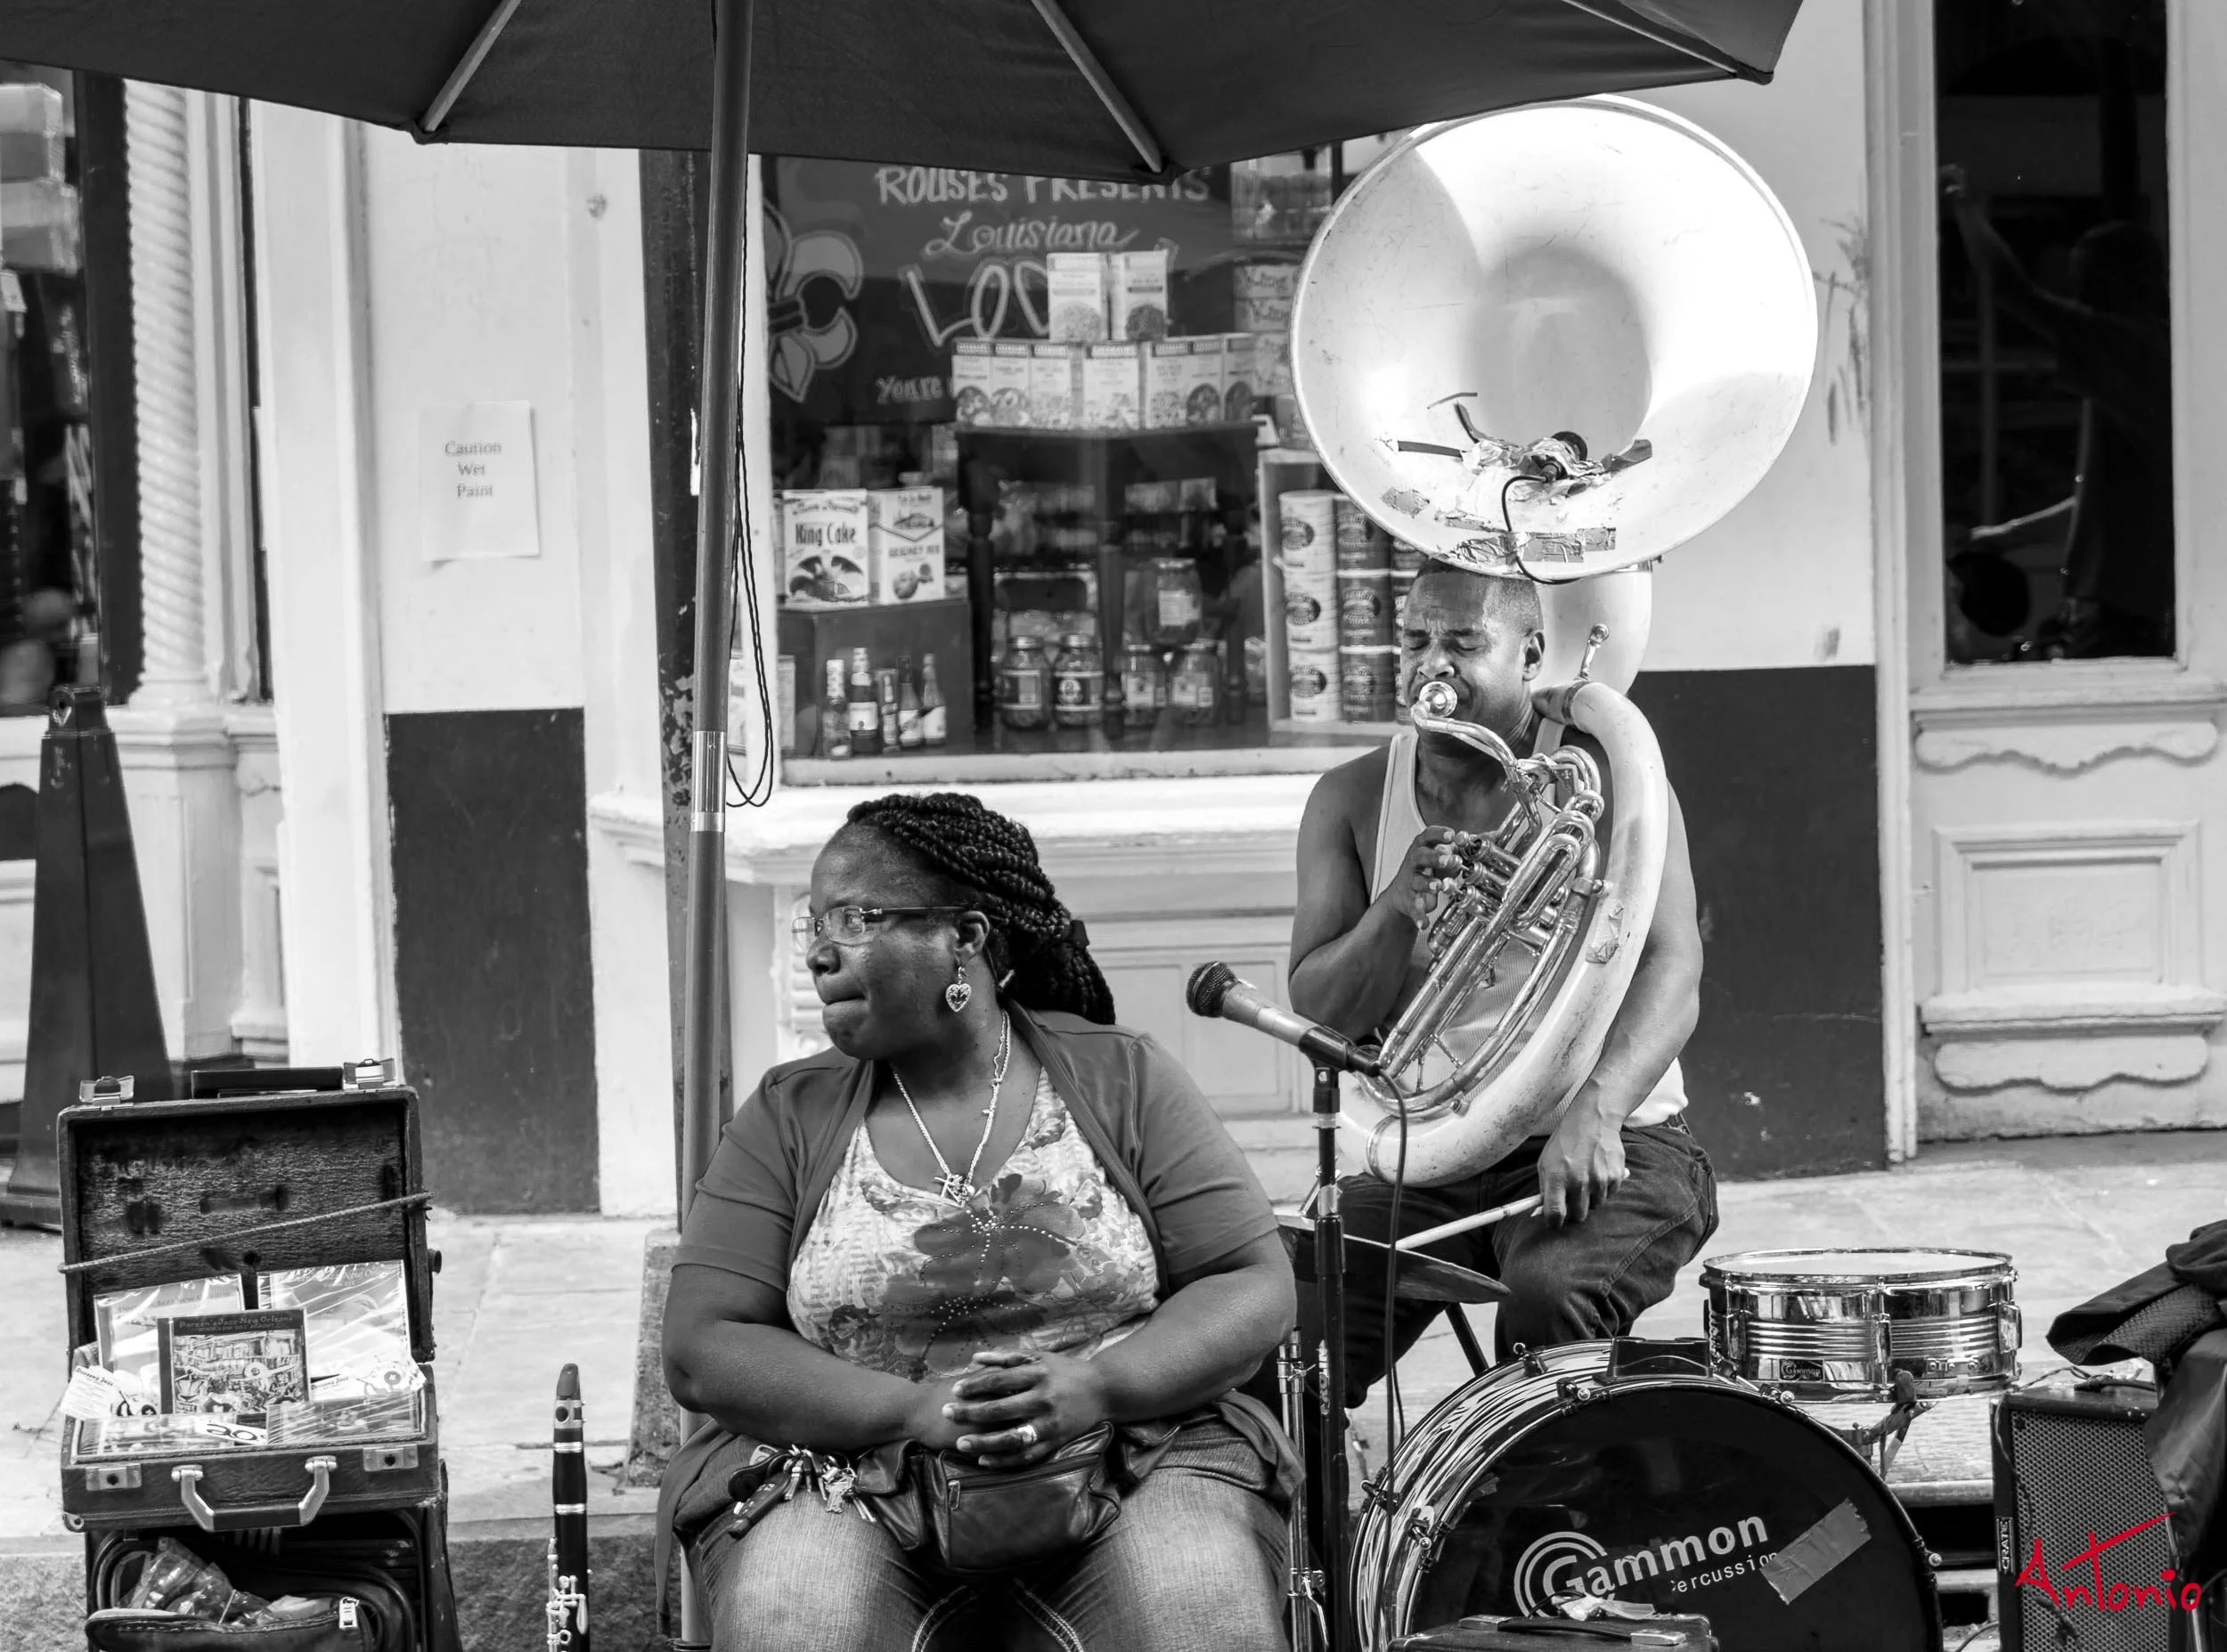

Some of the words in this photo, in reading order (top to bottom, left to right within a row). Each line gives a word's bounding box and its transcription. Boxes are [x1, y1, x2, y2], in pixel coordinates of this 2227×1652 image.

[874, 166, 1008, 205] ROUSES
[922, 210, 1140, 259] Louisiana
[444, 440, 502, 457] Caution
[457, 462, 485, 476] Wet
[456, 483, 494, 499] Paint
[795, 522, 822, 547] King
[827, 520, 856, 545] Cake
[259, 1314, 293, 1323] Orleans
[1542, 1516, 1768, 1597] Gammon
[2001, 1520, 2011, 1570] CRATE
[1670, 1550, 1779, 1592] ercussio
